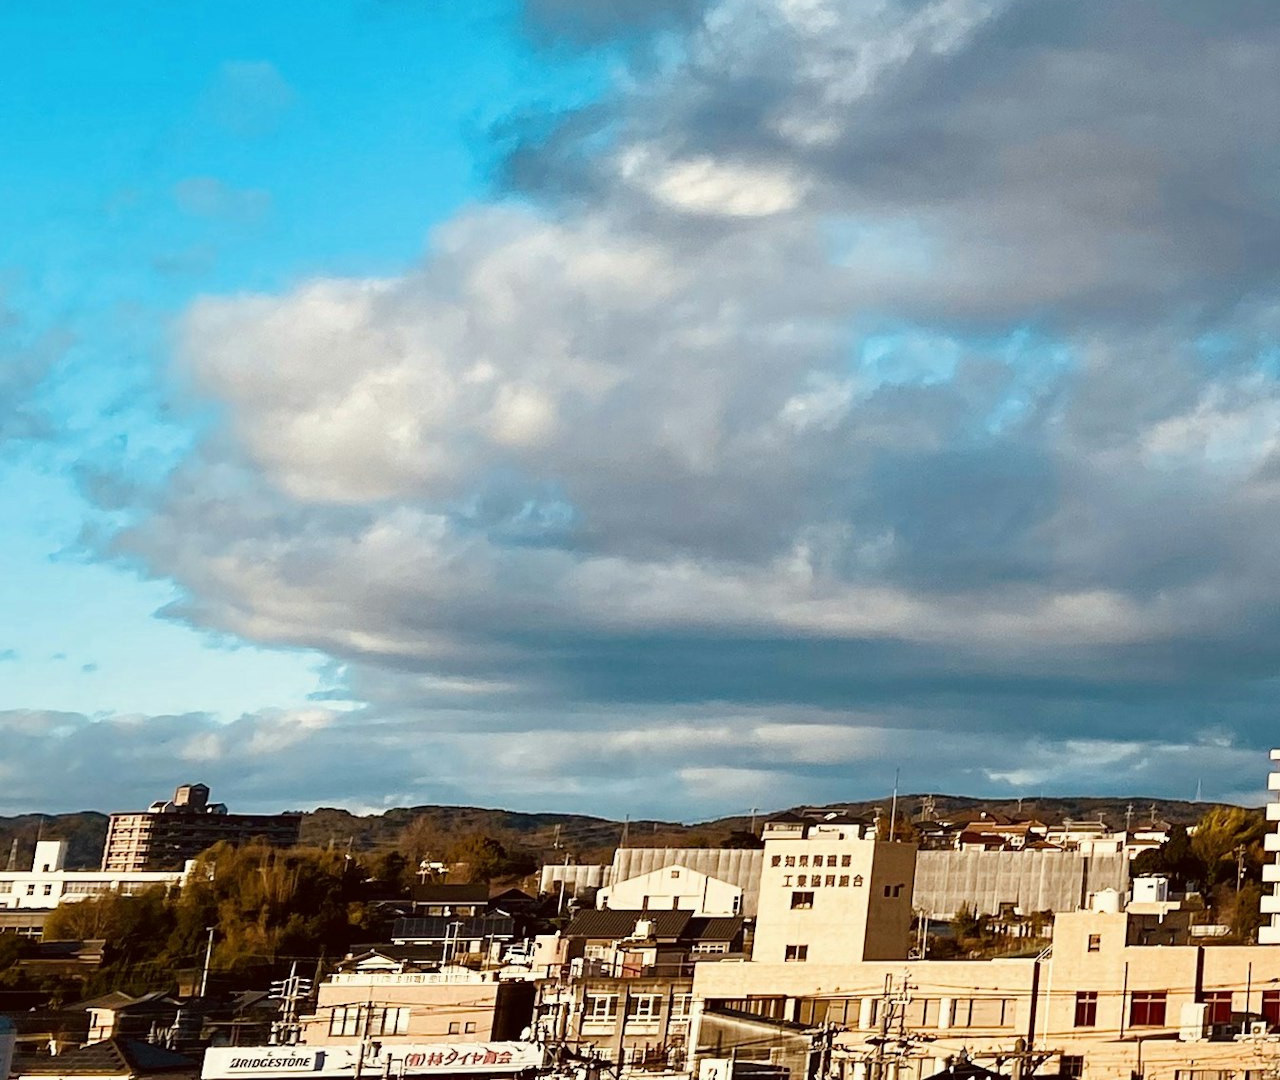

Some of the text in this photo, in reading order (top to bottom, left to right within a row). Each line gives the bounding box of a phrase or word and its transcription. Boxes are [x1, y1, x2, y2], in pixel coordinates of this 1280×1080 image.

[782, 874, 864, 888] 工業協同組合
[230, 1057, 311, 1069] BRIDGESTONE
